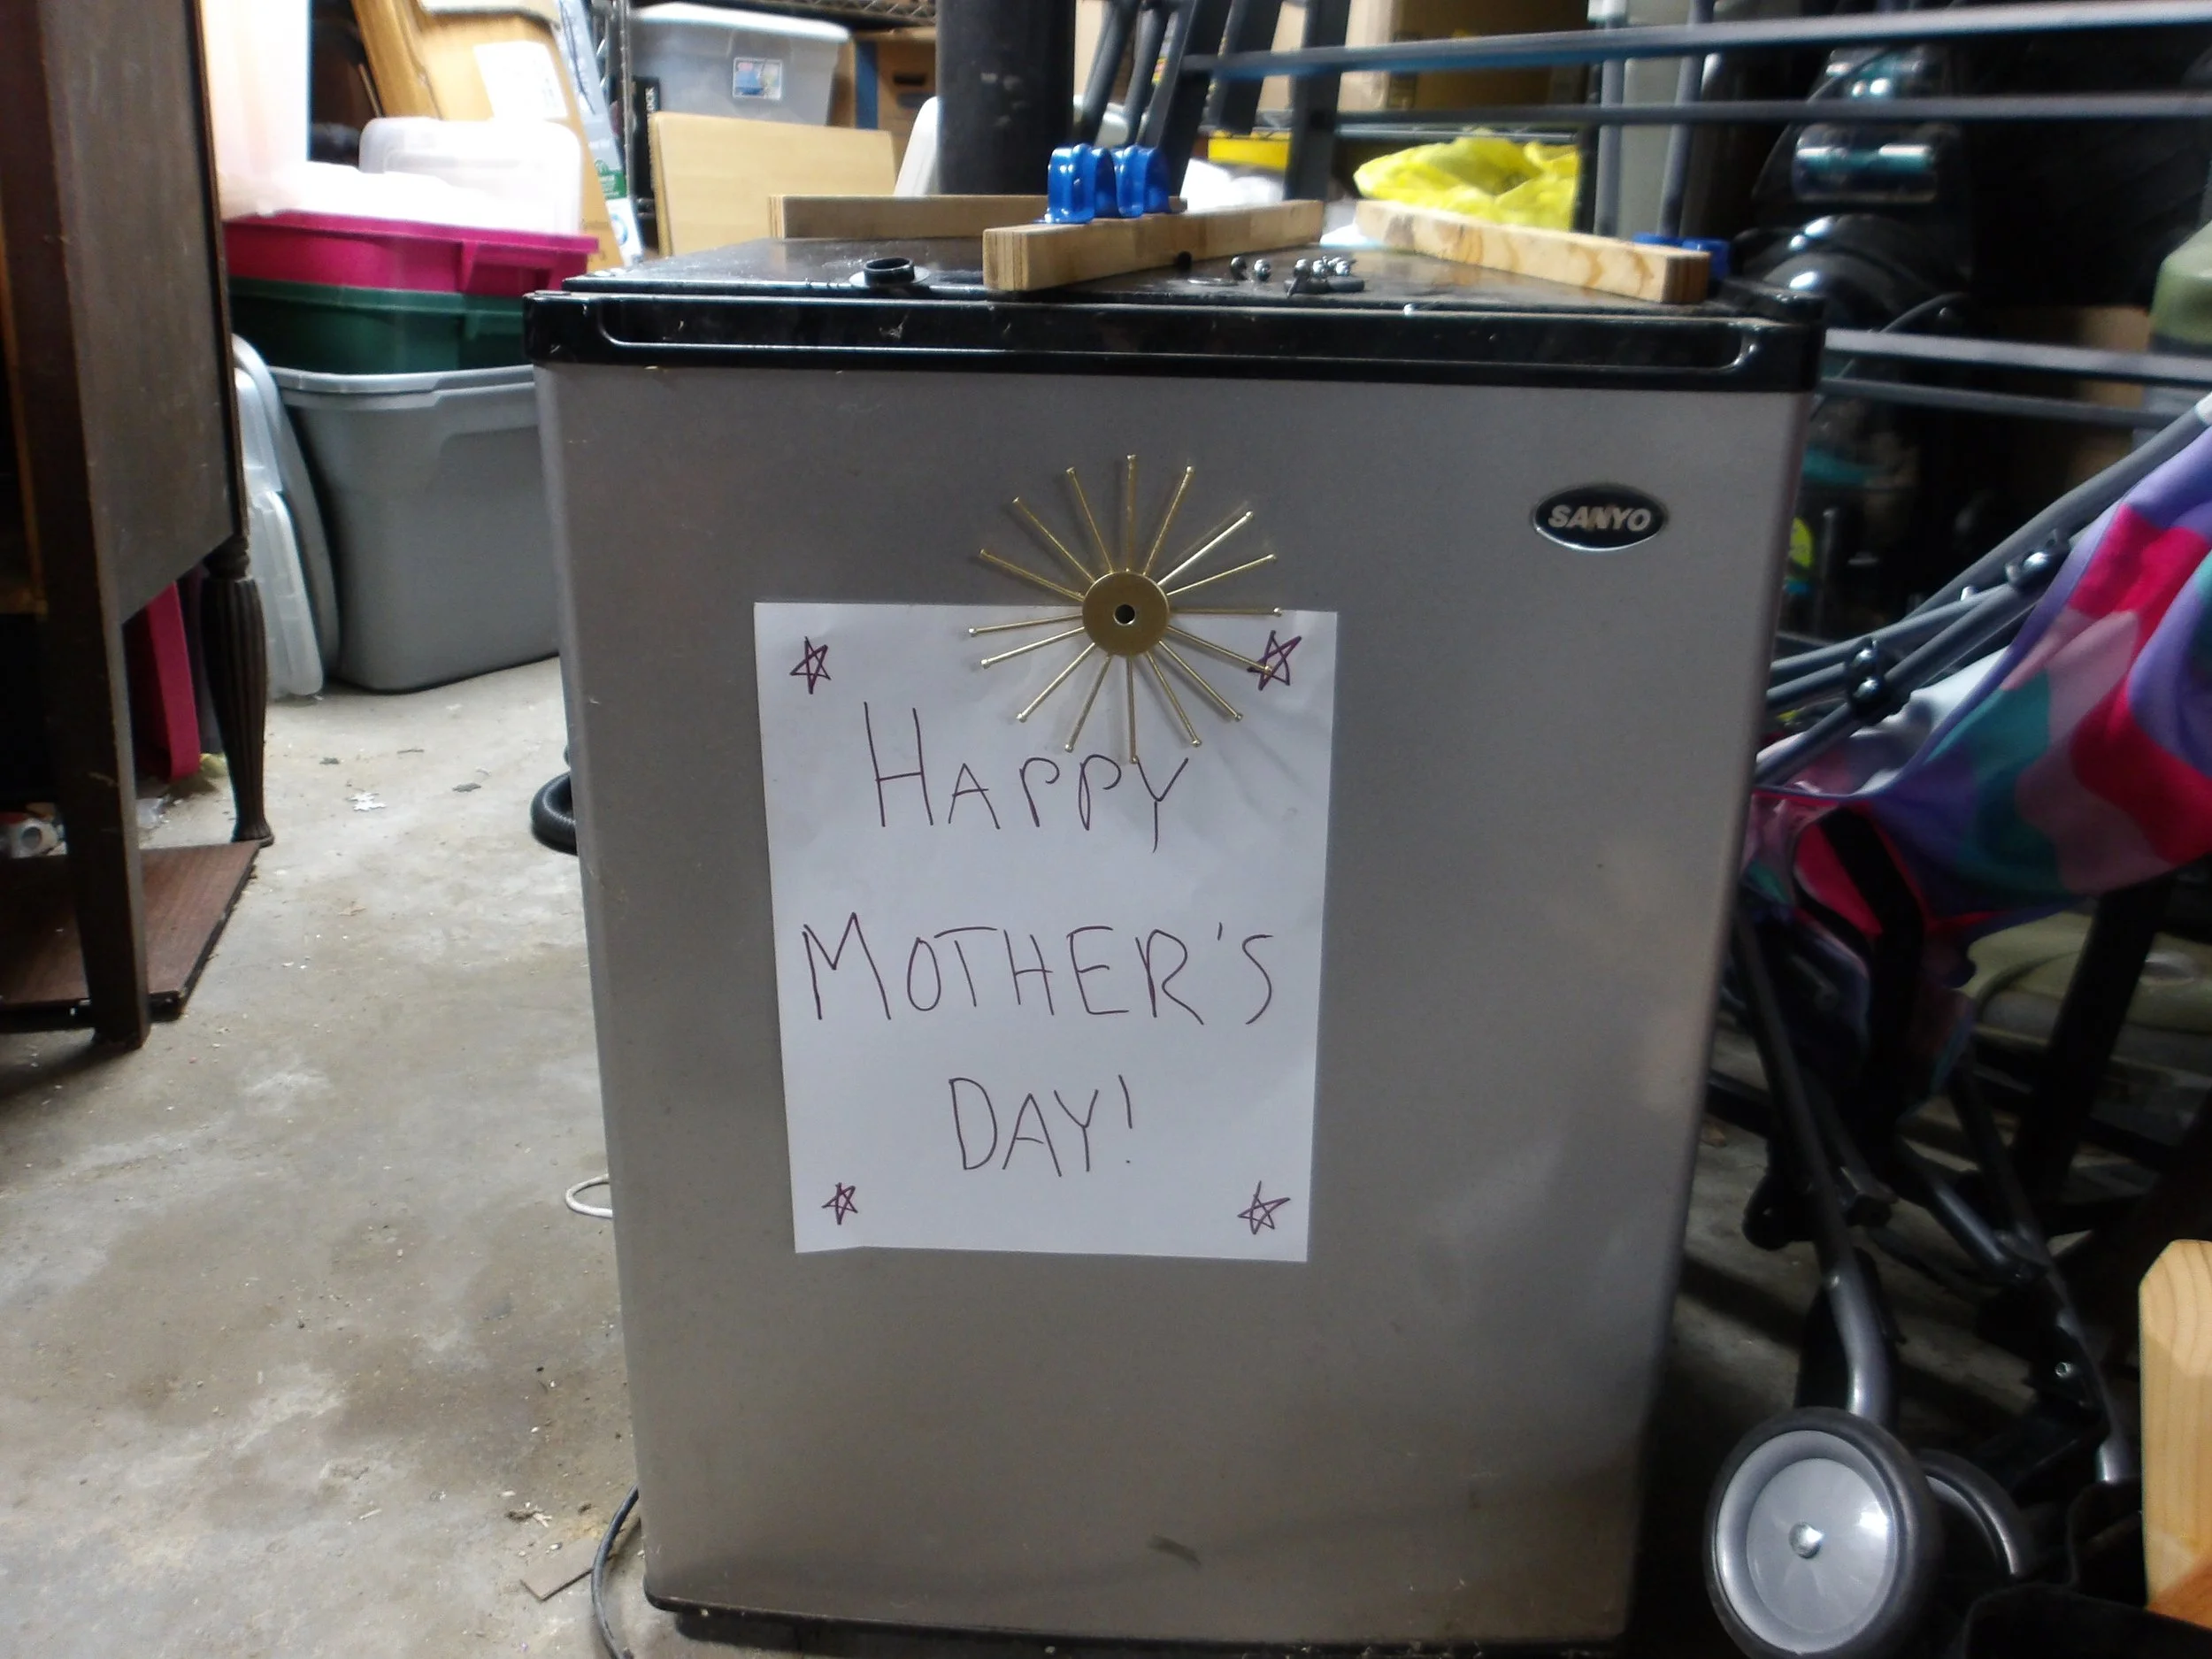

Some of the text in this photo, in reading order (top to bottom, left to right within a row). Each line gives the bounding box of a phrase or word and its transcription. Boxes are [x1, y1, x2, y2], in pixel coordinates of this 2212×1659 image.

[1548, 504, 1652, 532] SANYO
[863, 702, 1190, 853] HAPPY
[803, 911, 1274, 1026] MOTHER'S
[949, 1075, 1133, 1177] DAY!
